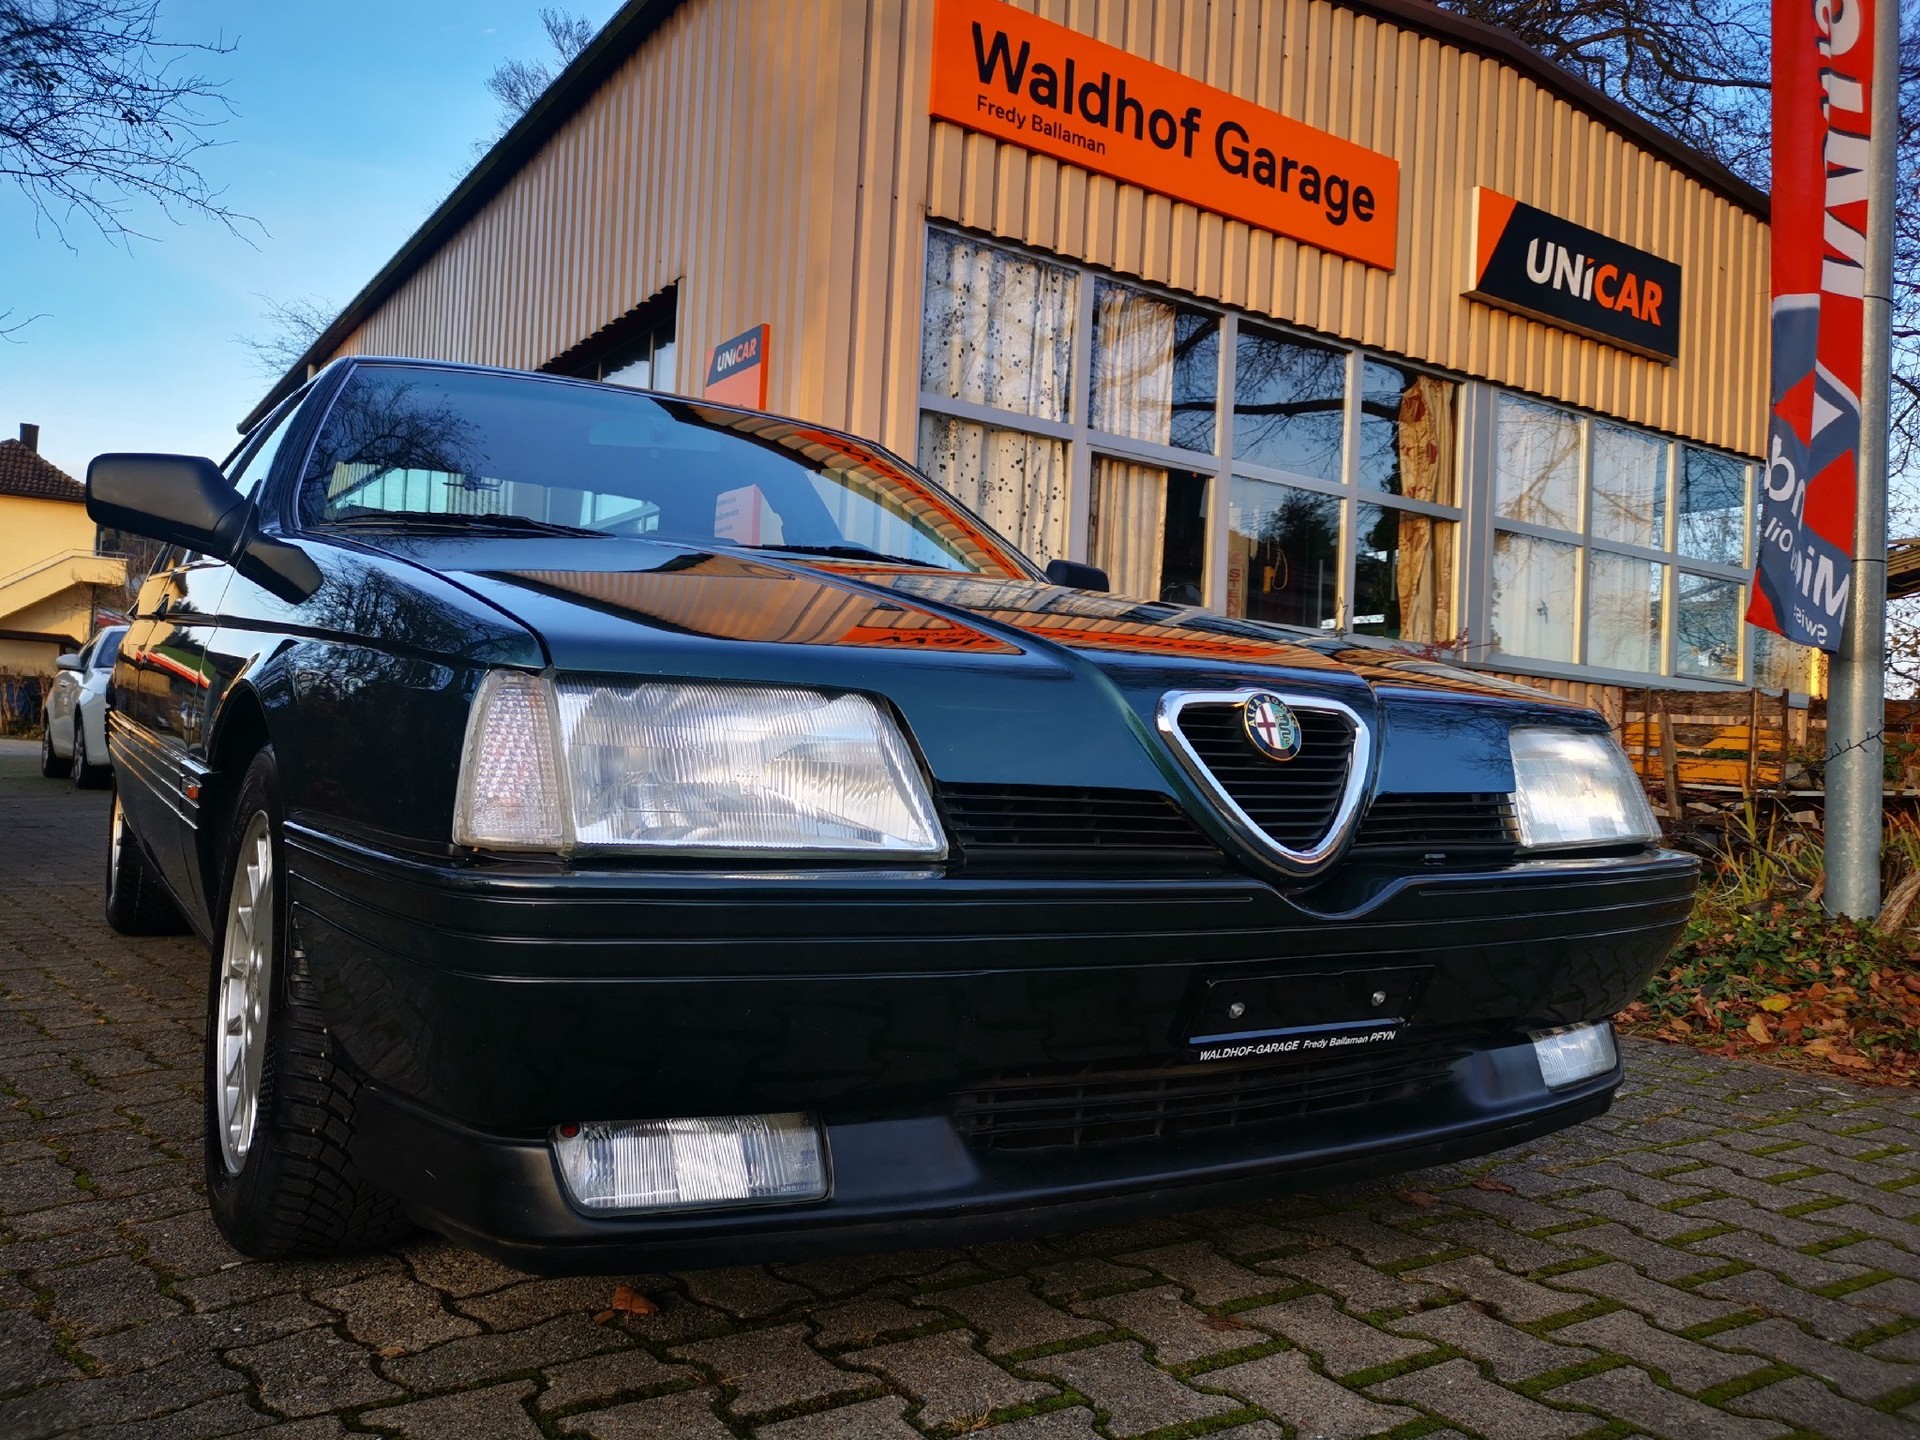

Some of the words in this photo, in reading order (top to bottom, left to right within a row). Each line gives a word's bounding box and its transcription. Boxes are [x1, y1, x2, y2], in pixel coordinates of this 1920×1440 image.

[971, 21, 1202, 159] Waldhof
[1214, 120, 1376, 226] Garage
[977, 95, 1027, 131] Fredy
[1031, 114, 1106, 156] Ballaman
[1248, 698, 1262, 728] ALFA
[1200, 1040, 1300, 1061] WALDHOF-GARAGE
[1303, 1038, 1328, 1049] Fredy
[1329, 1035, 1369, 1047] Ballaman
[1370, 1030, 1396, 1042] PFYN
